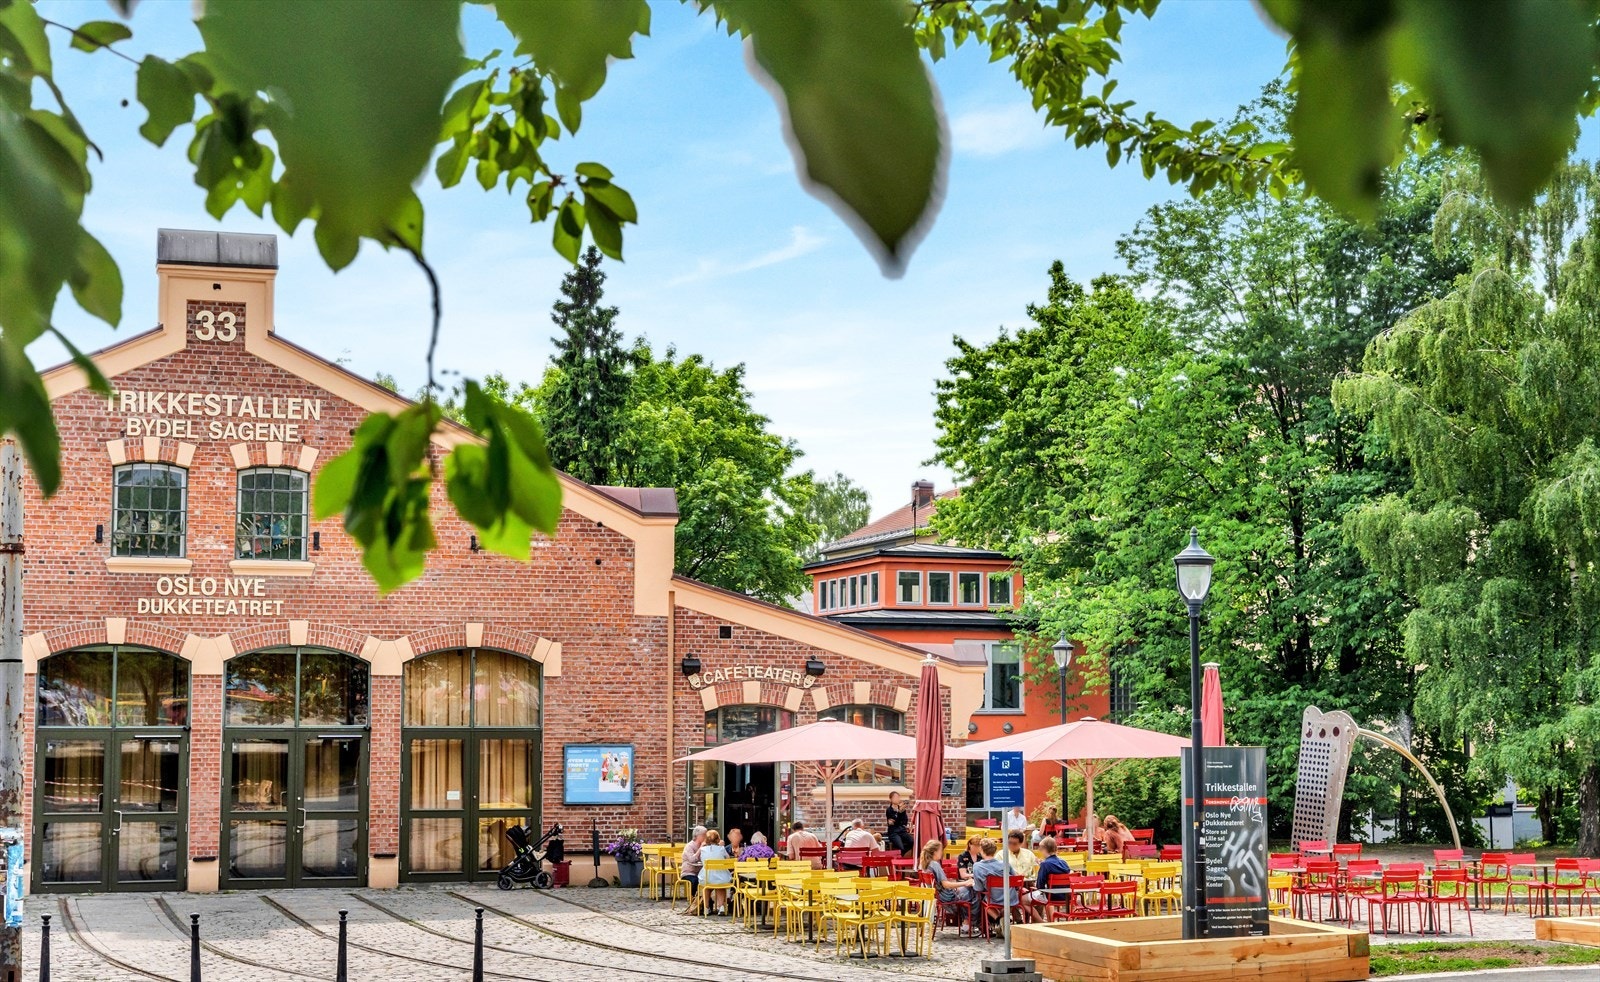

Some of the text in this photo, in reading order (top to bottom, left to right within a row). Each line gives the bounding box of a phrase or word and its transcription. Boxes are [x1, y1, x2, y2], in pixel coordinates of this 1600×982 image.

[195, 310, 237, 341] 33
[107, 390, 320, 420] TRIKKESTALLEN
[126, 417, 299, 442] BYDEL SAGENE
[156, 576, 266, 597] OSLO NYE
[137, 598, 284, 616] DUKKETEATRET
[703, 663, 801, 685] CAFÉ TEATER
[1205, 783, 1257, 792] Trikkestallen
[1220, 812, 1232, 820] Nye
